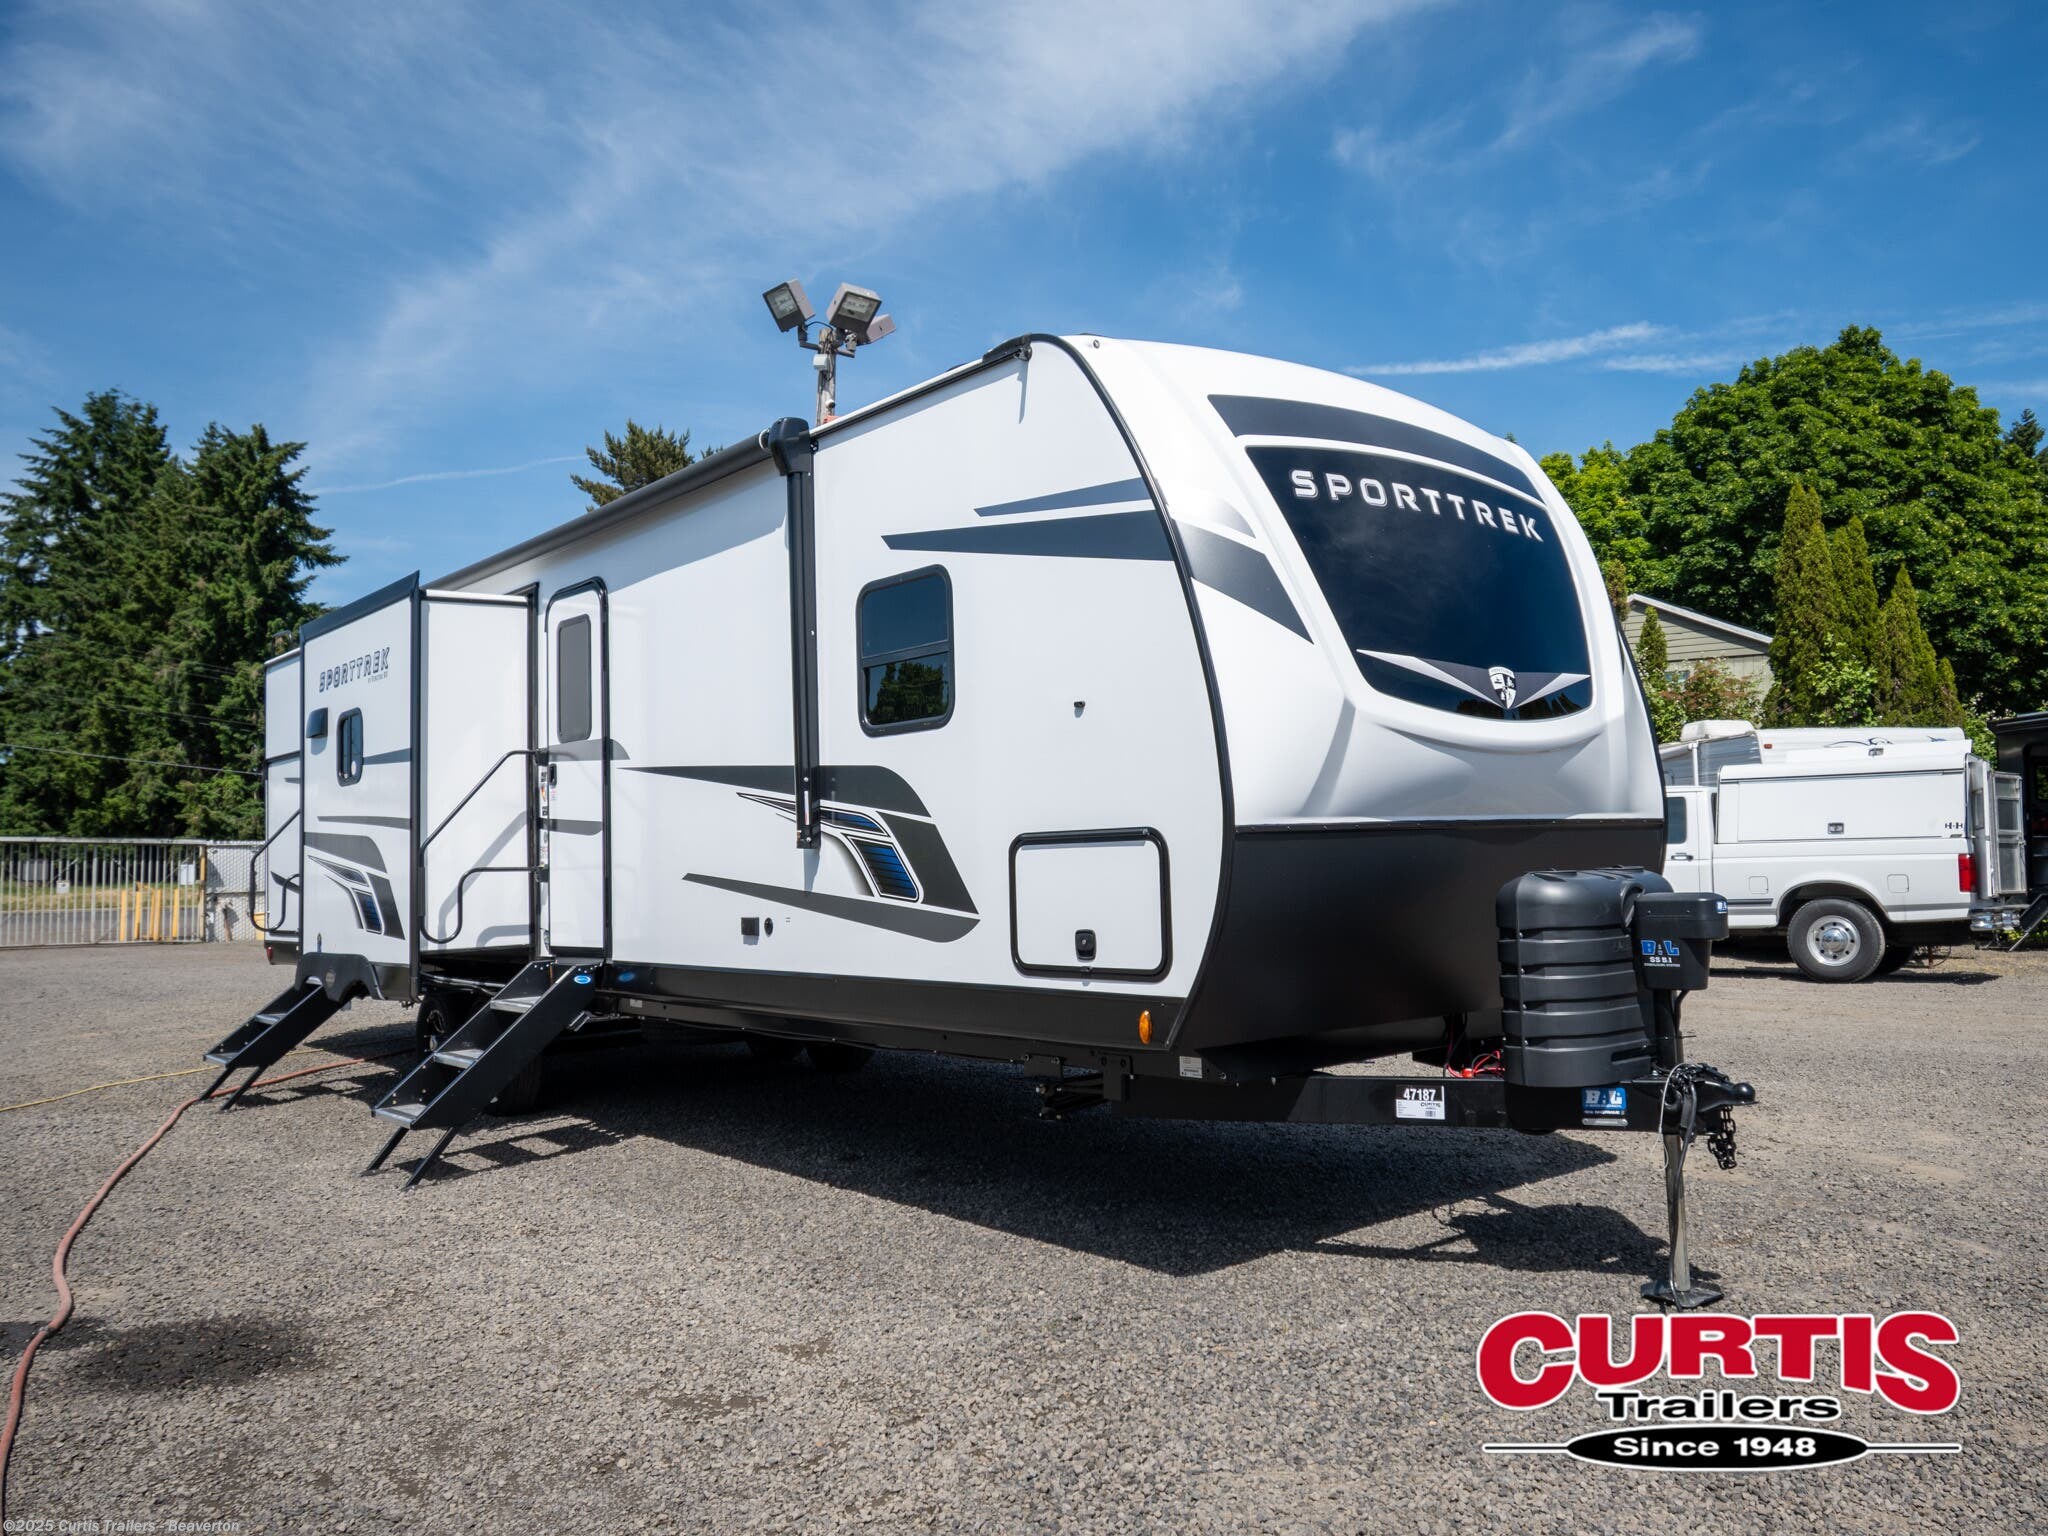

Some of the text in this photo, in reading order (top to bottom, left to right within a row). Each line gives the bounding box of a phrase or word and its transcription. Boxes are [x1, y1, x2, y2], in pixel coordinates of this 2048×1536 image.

[1289, 468, 1545, 543] SPORTTREK
[319, 646, 390, 693] SPORTTREK
[1403, 1088, 1436, 1101] 47187
